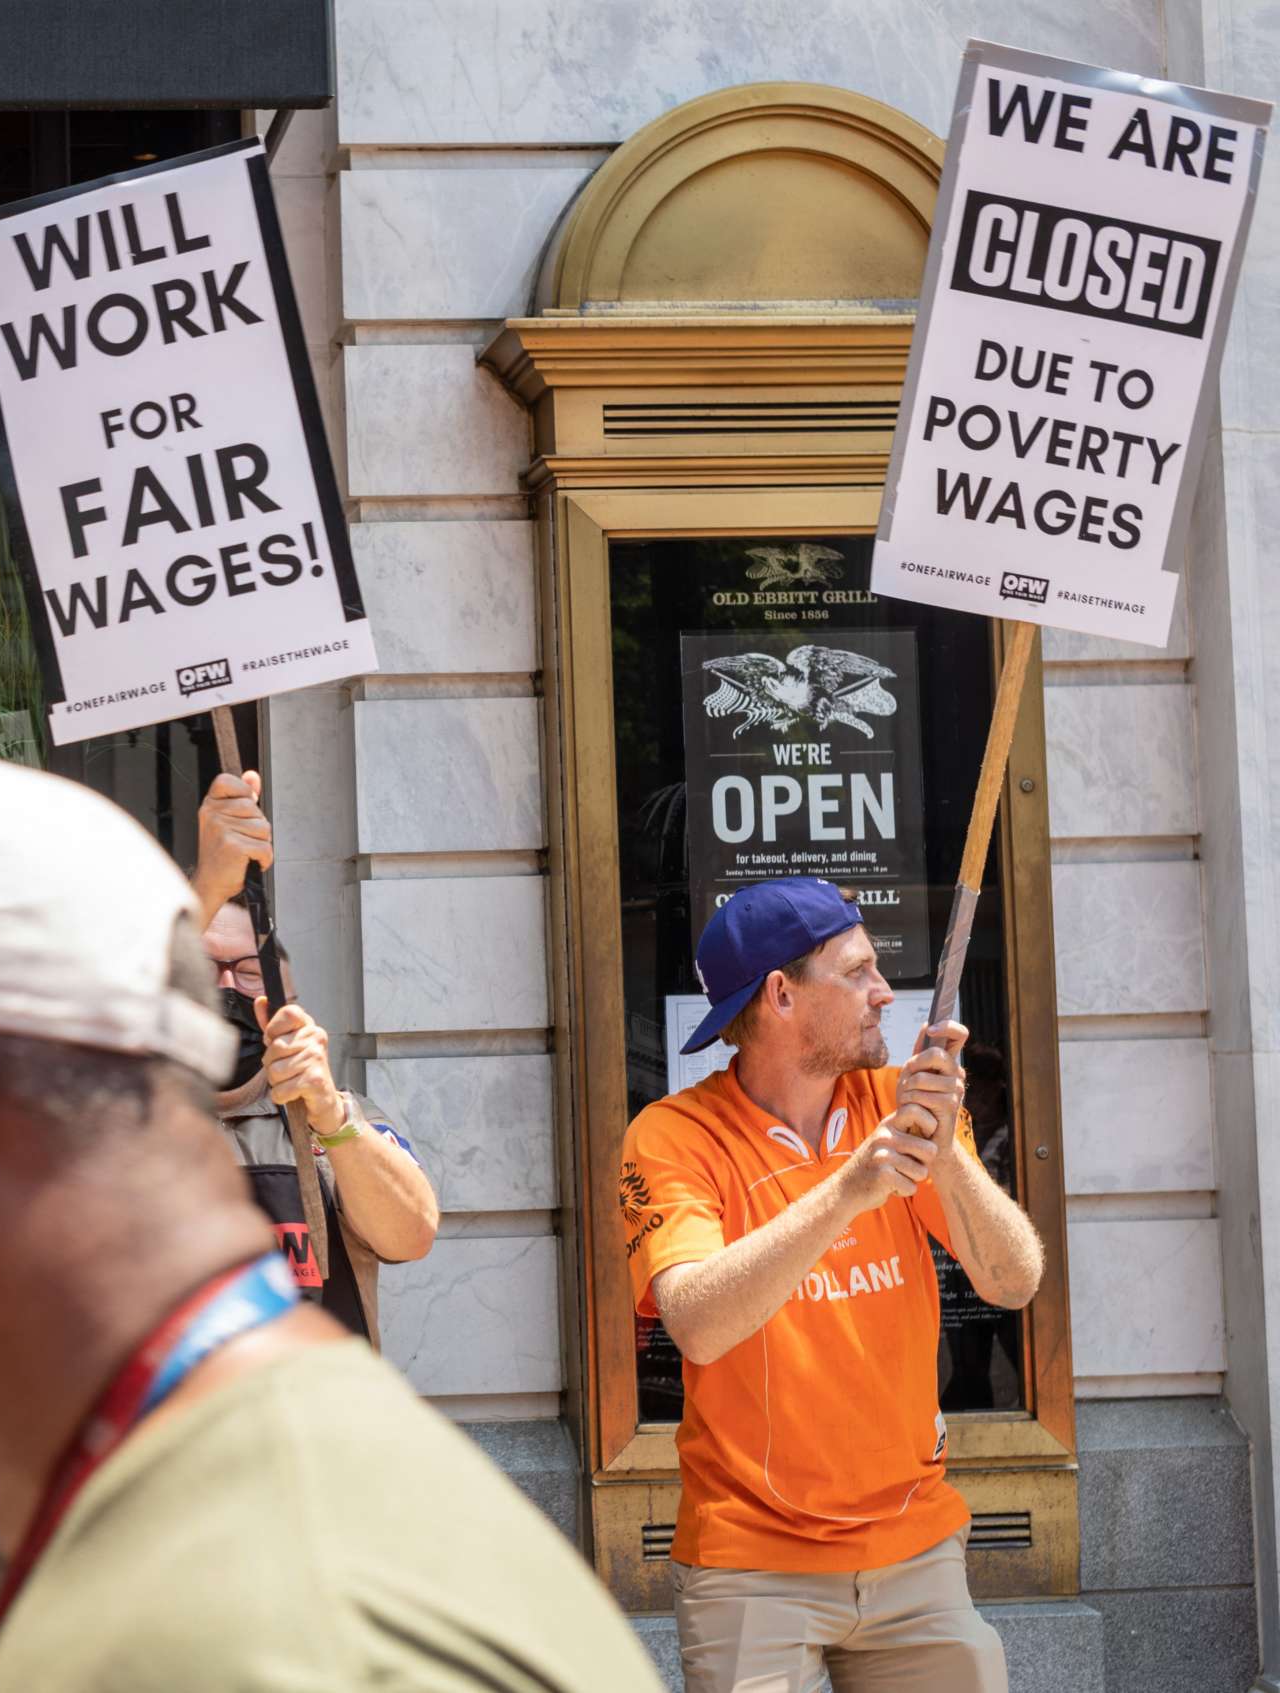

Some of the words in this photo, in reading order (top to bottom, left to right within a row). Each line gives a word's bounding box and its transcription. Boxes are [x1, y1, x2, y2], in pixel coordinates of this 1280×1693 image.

[985, 78, 1092, 153] WE
[1108, 108, 1239, 185] ARE
[12, 192, 212, 292] WILL
[967, 202, 1207, 325] CLOSED
[0, 261, 265, 381] WORK
[973, 339, 1074, 397] DUE
[1089, 359, 1155, 410] TO
[100, 392, 203, 449] FOR
[922, 396, 1181, 485] POVERTY
[59, 443, 282, 559] FAIR
[935, 468, 1144, 549] WAGES
[43, 522, 325, 637] WAGES!
[900, 561, 991, 586] #ONEFAIRWAGE
[1004, 575, 1047, 595] OFW
[713, 592, 750, 606] OLD
[753, 591, 818, 605] EBBITT
[822, 590, 878, 604] GRILL
[764, 609, 797, 621] Since
[800, 609, 830, 621] 1856
[1057, 590, 1146, 615] #RAISETHEWAGE
[179, 661, 226, 686] OFW
[242, 640, 350, 671] #RAISETHEWAGE
[66, 682, 167, 713] #ONEFAIRWAGE
[772, 743, 832, 766] WE'RE
[711, 772, 896, 844] OPEN
[736, 854, 748, 865] for
[752, 853, 789, 865] takeout,
[791, 852, 829, 865] delivery,
[831, 851, 848, 863] and
[850, 851, 878, 864] dining
[856, 890, 900, 906] RILL
